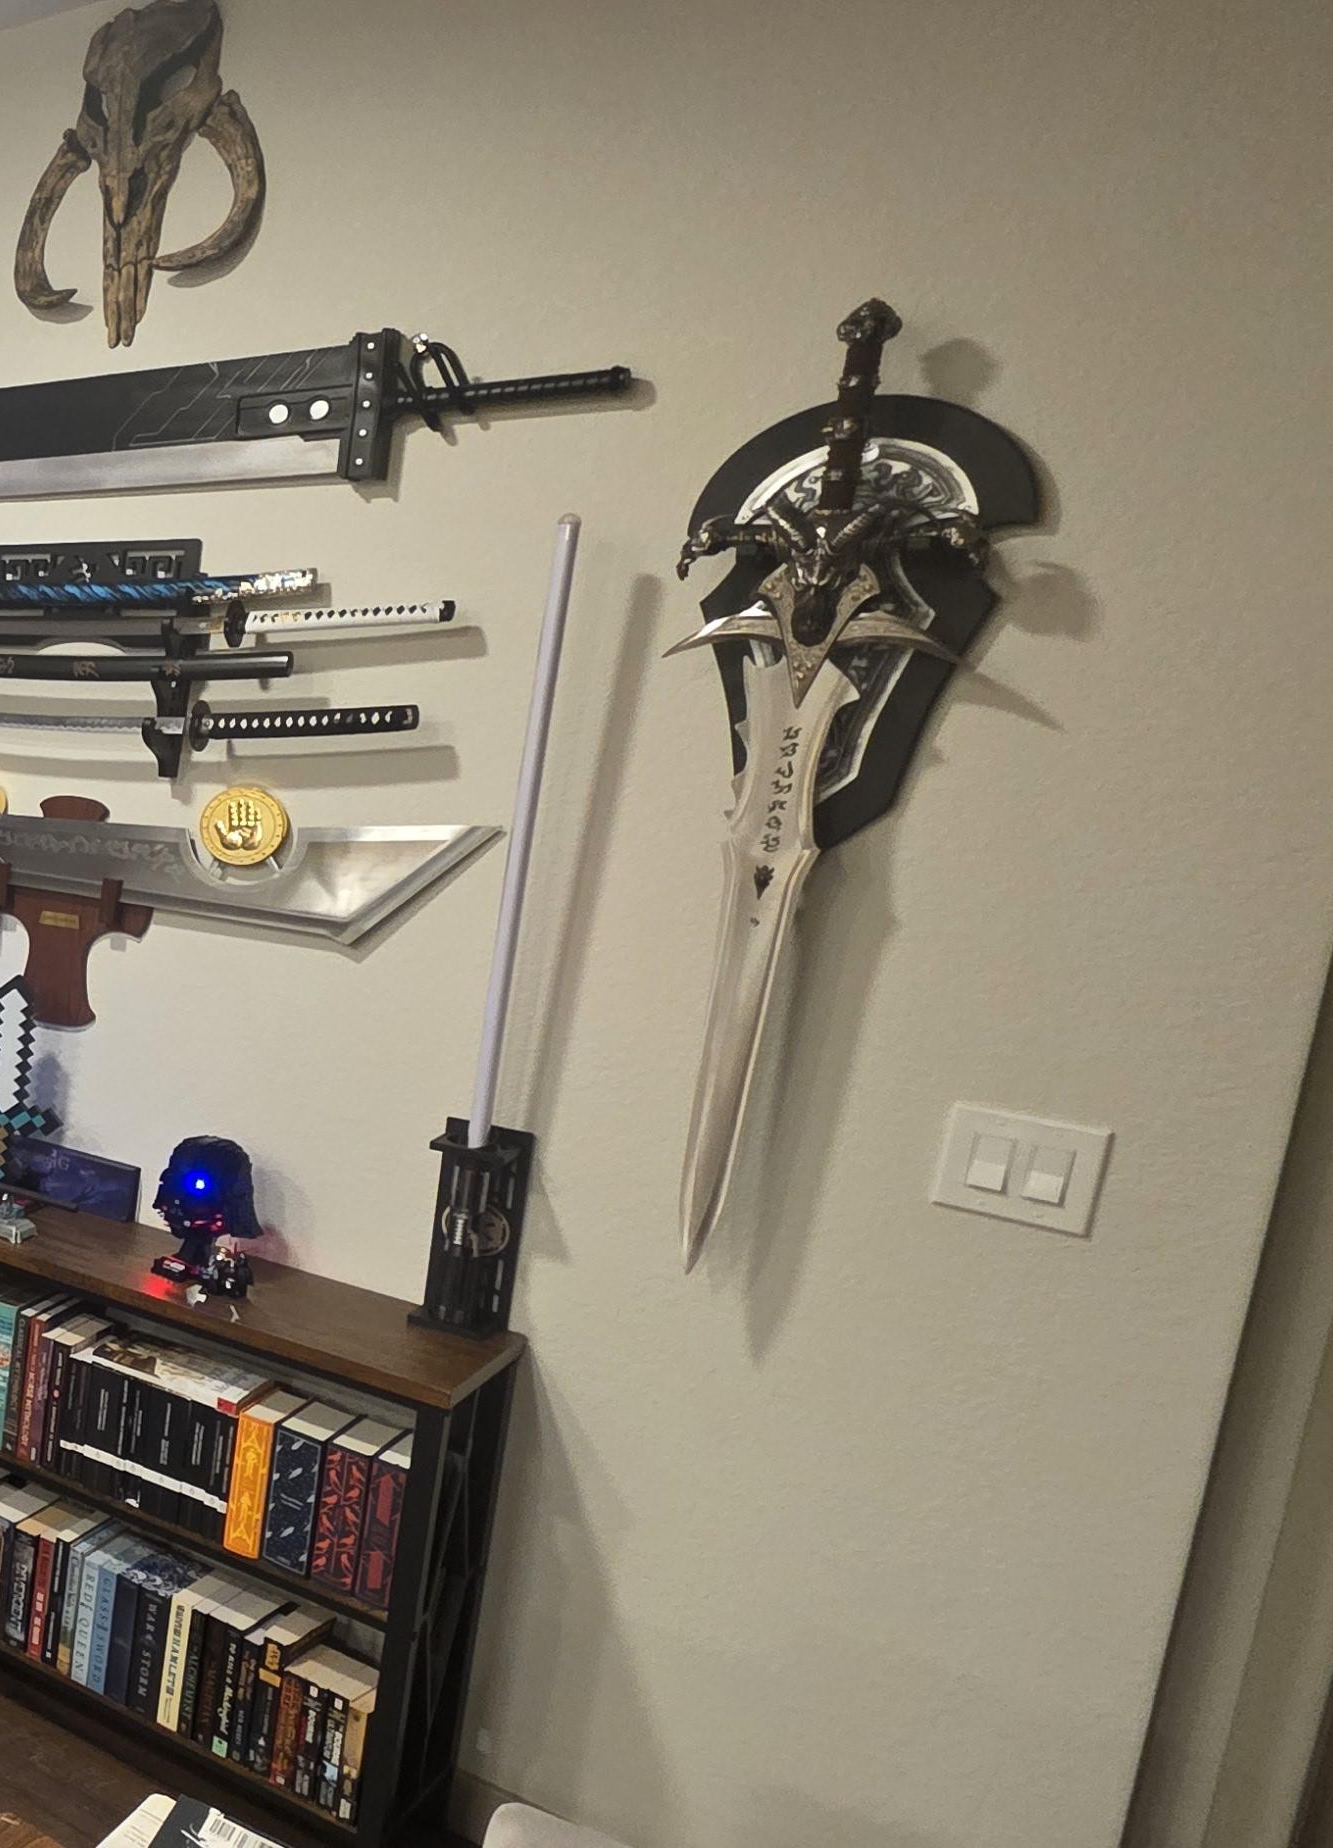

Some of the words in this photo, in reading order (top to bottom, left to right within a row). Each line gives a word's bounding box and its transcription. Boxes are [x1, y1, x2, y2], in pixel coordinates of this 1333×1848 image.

[27, 1372, 37, 1405] NORSE
[21, 1405, 35, 1446] MYTHOLOGY
[85, 1573, 95, 1605] RED
[101, 1576, 112, 1622] GLASS
[74, 1615, 90, 1671] QUEEN
[91, 1634, 106, 1685] SWORD
[137, 1649, 152, 1697] STORM
